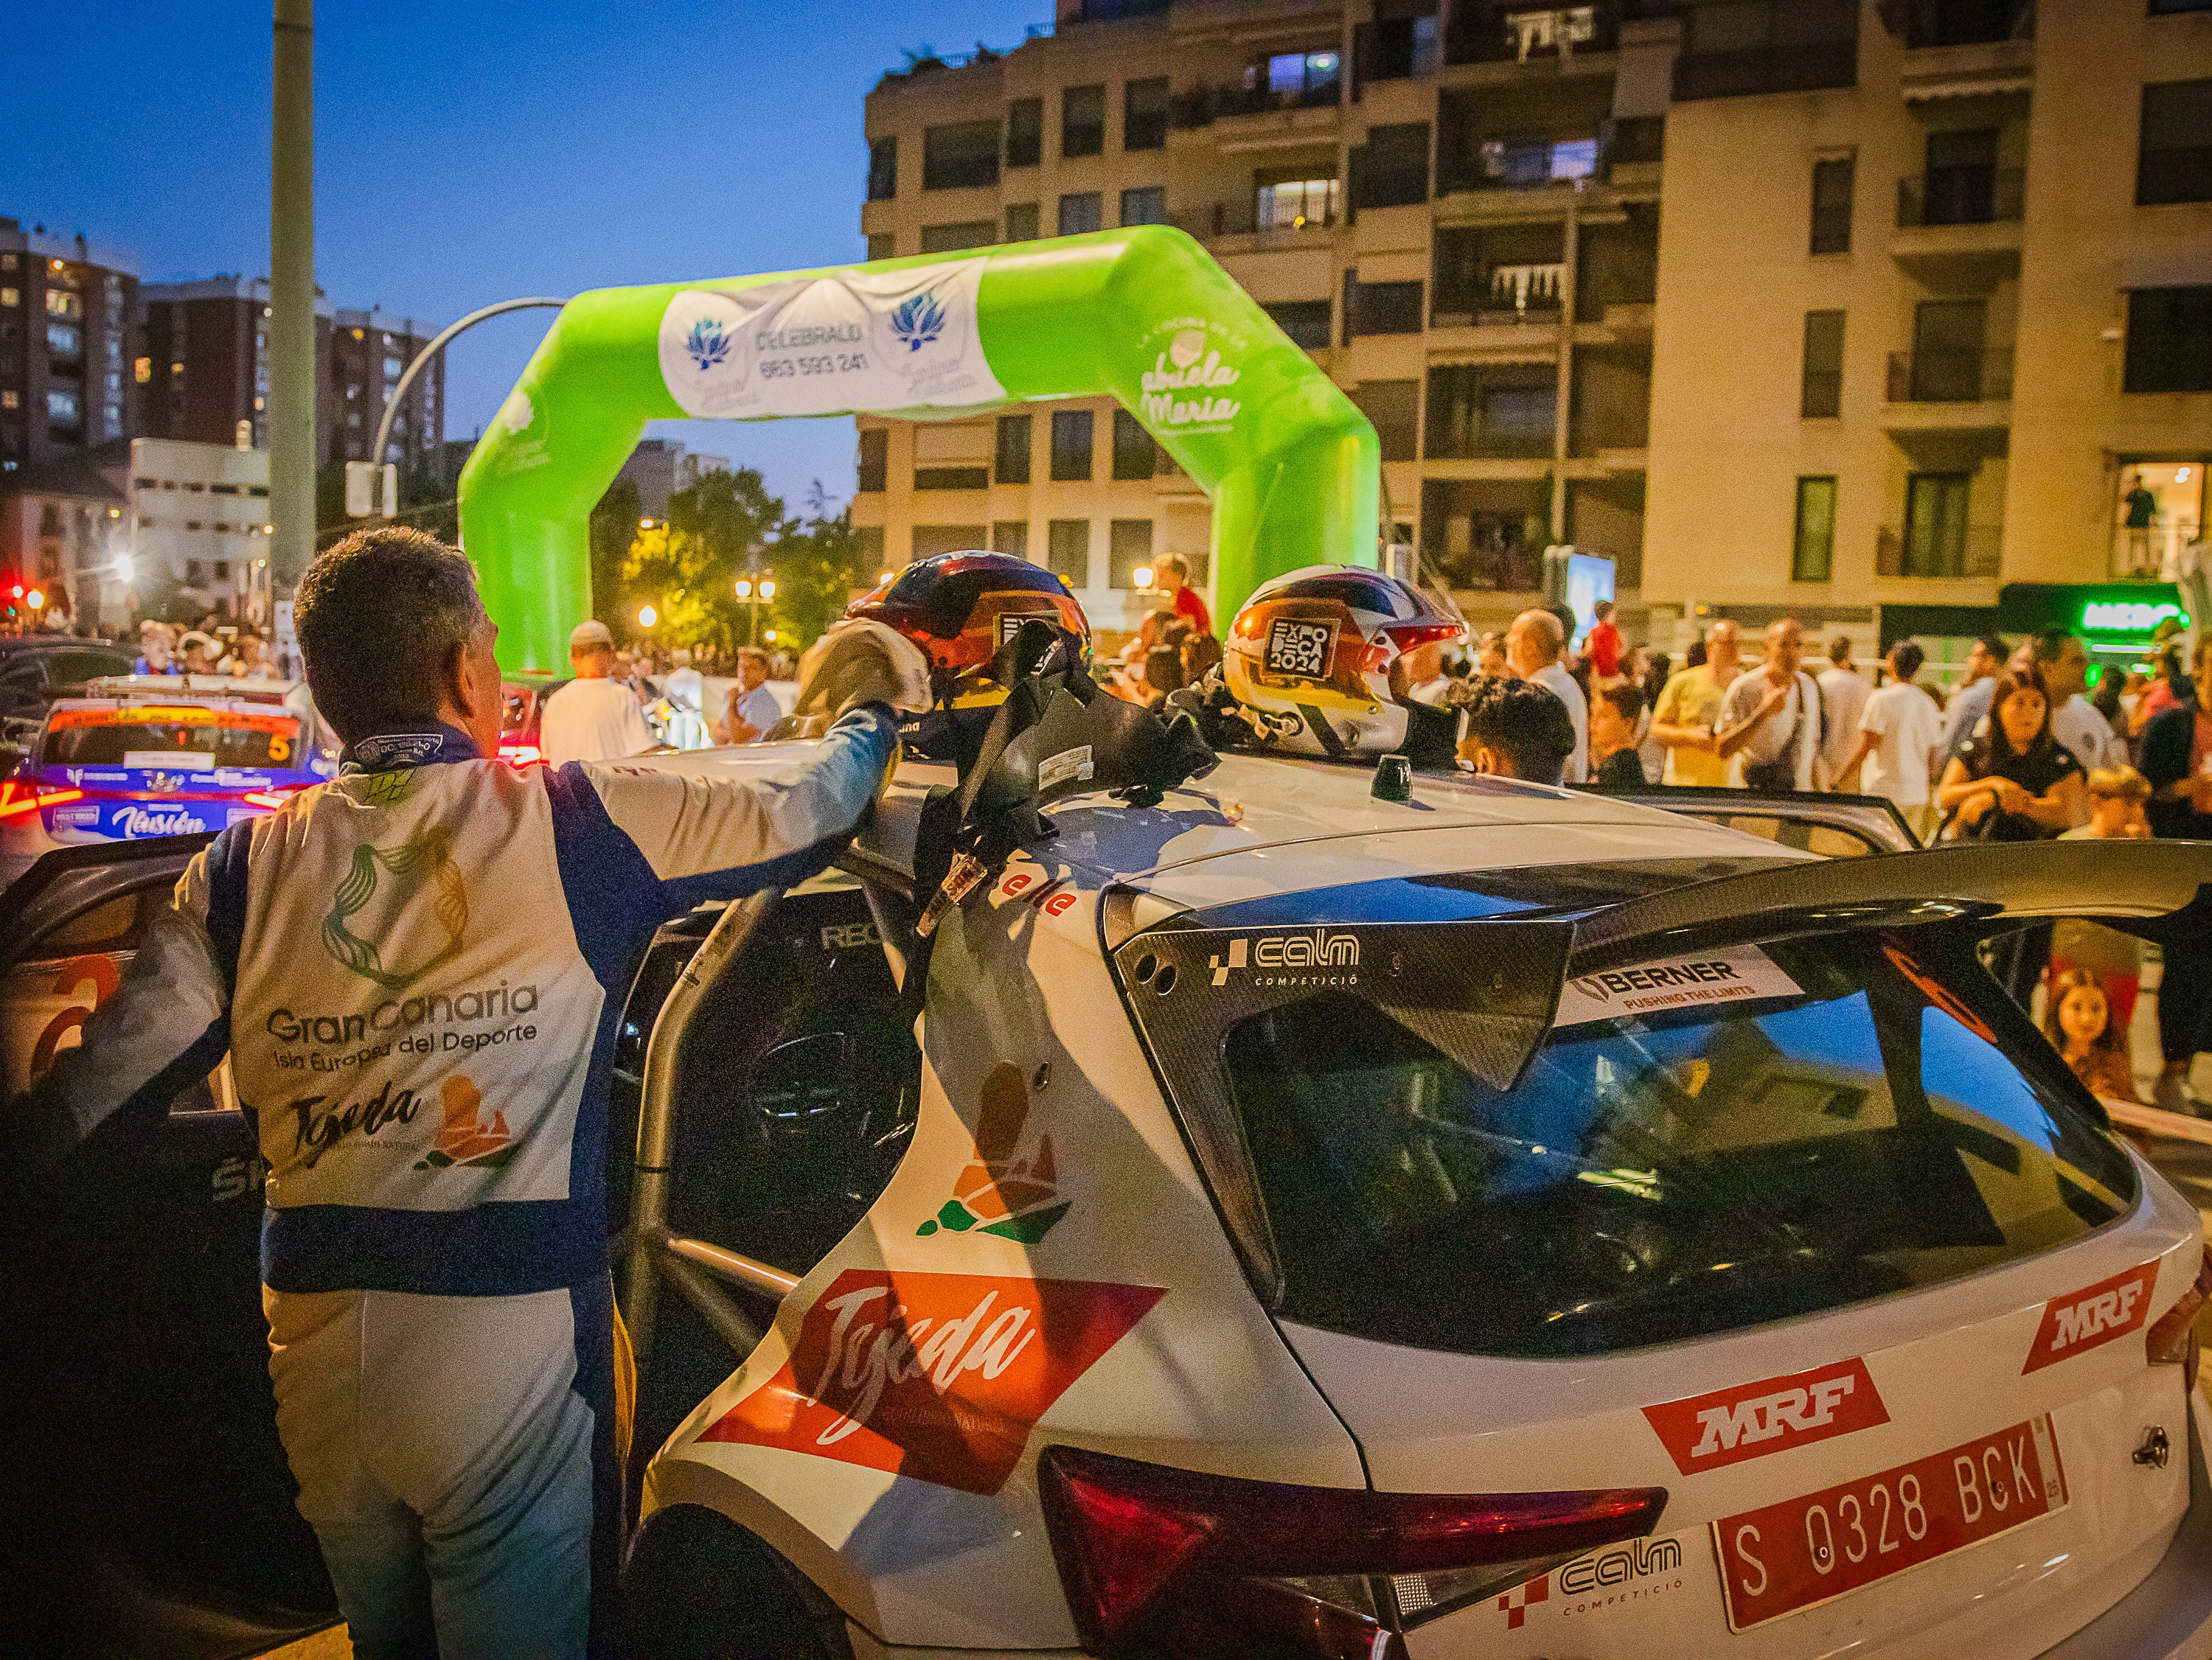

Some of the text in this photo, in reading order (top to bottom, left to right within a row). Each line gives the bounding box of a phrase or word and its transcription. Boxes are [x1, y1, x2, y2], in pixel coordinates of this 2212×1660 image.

[1141, 349, 1241, 392] abuela
[1270, 635, 1323, 659] DECA
[1273, 621, 1327, 643] EXPO
[1269, 652, 1321, 674] 2024
[268, 733, 290, 761] 5
[1255, 928, 1360, 967] calm
[1255, 974, 1358, 986] COMPETICIÓ
[1599, 960, 1742, 994] BERNER
[266, 978, 539, 1045] Gran Canaria
[1623, 986, 1757, 1011] PUSHING THE LIMITS
[274, 1049, 309, 1070] Isla
[397, 1031, 435, 1053] del
[442, 1022, 538, 1056] Deporte
[2049, 1279, 2143, 1351] MRF
[806, 1286, 1037, 1445] Tejeda
[1691, 1373, 1857, 1458] MRF
[1735, 1434, 2037, 1597] S 0328 BCK
[1559, 1538, 1682, 1595] calm
[1563, 1577, 1683, 1617] COMPETICIÓ
